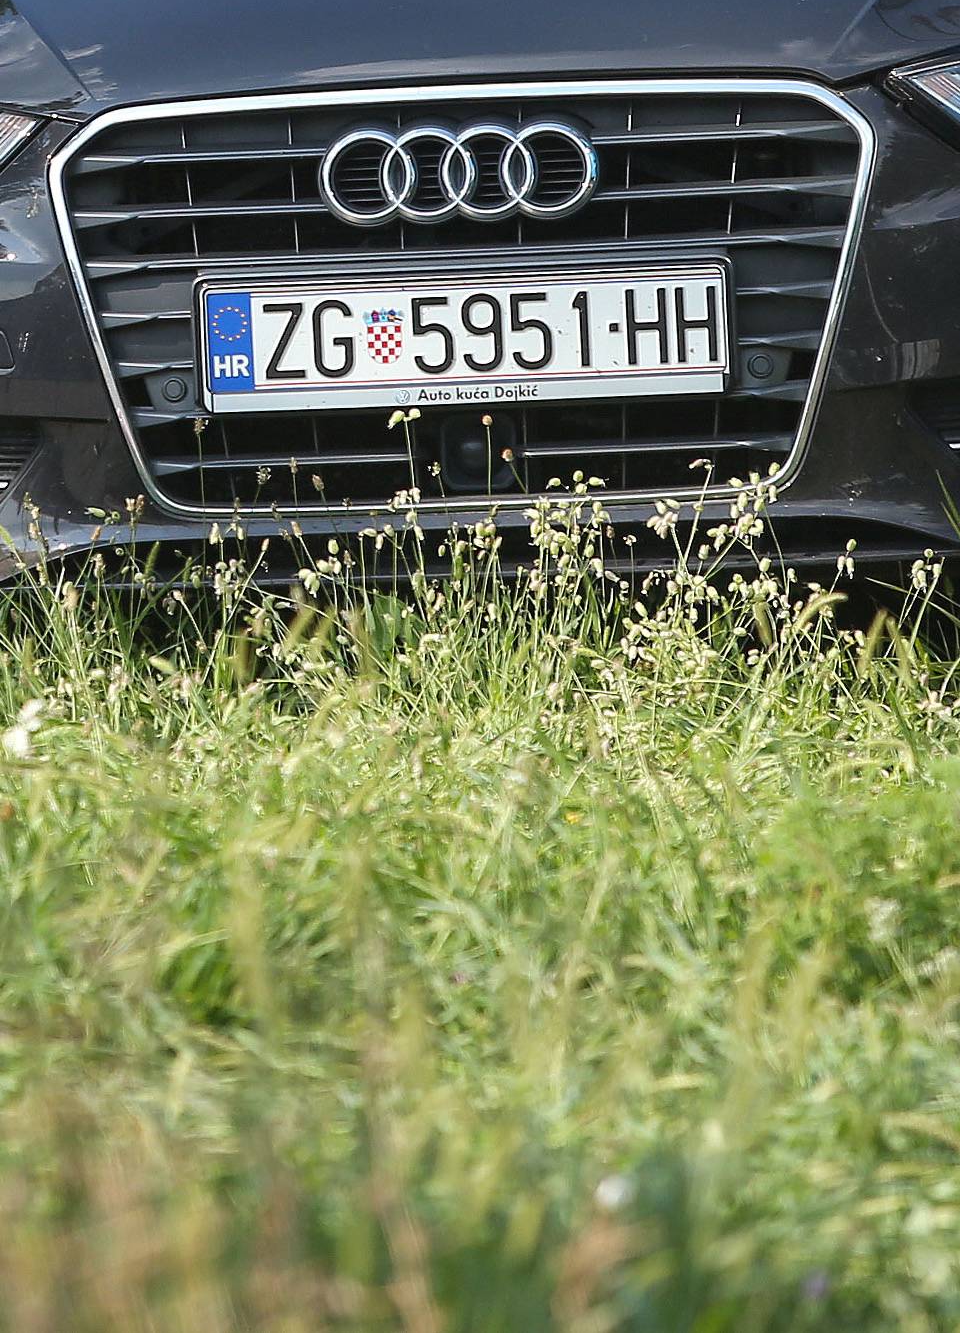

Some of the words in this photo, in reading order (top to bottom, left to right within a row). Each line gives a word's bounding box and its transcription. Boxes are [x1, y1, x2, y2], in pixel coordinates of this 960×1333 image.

[262, 299, 355, 381] ZG
[213, 354, 249, 380] HR
[418, 389, 452, 401] Auto
[456, 387, 490, 400] kuća
[494, 385, 539, 401] Dojkić
